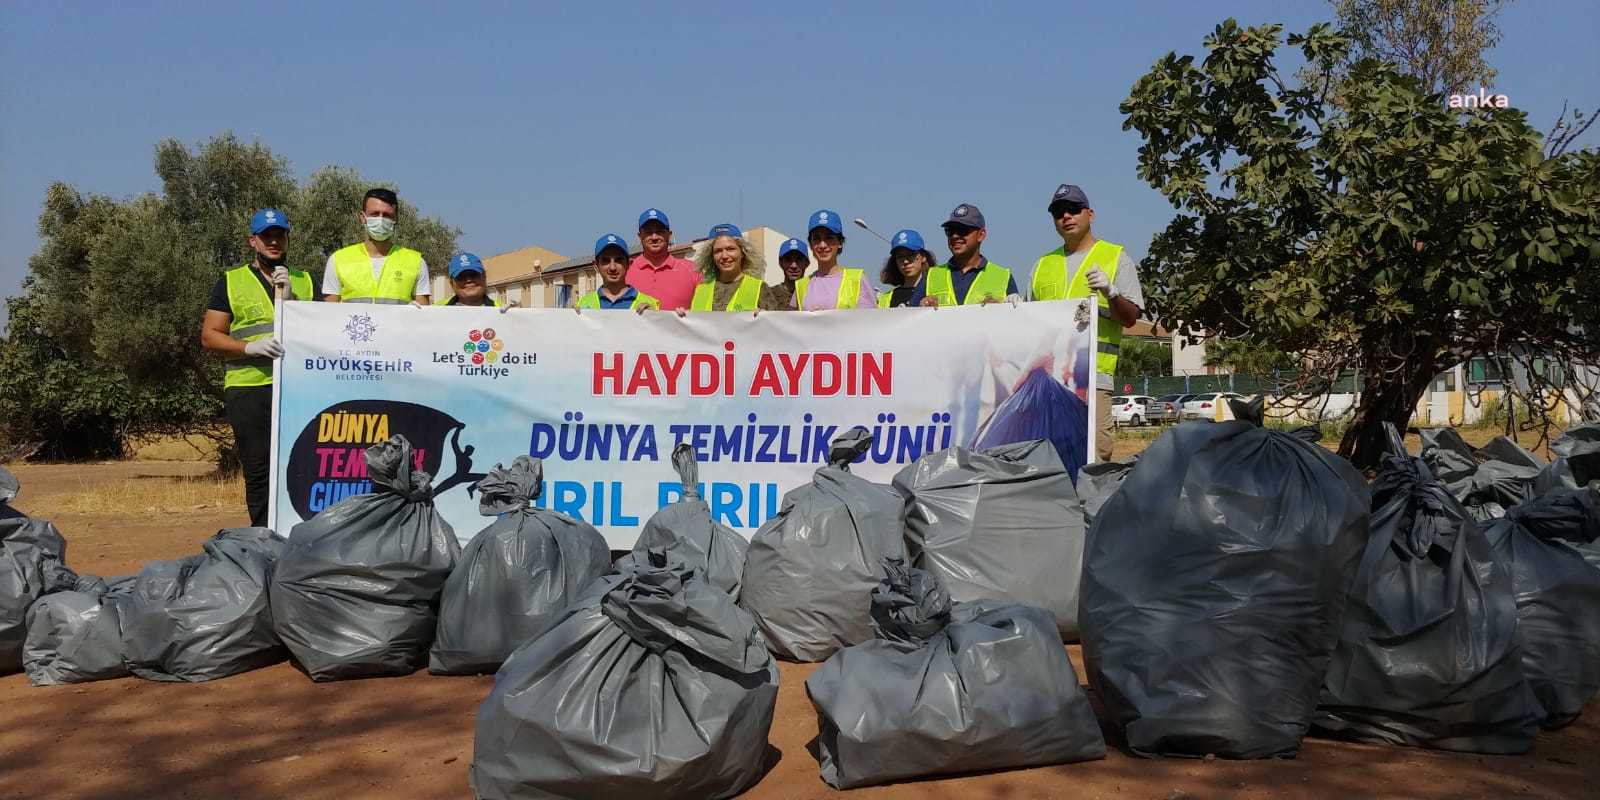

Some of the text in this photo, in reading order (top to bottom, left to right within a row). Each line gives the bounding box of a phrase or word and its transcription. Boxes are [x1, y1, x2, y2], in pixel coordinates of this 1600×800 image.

[305, 356, 413, 374] BÜYÜKŞEHİR
[432, 352, 537, 364] Let's do it!
[591, 340, 893, 396] HAYDİ AYDIN
[458, 365, 509, 379] Türkiye
[317, 410, 390, 444] DÜNYA
[530, 411, 659, 461] DÜNYA
[670, 413, 839, 464] TEMİZLİK
